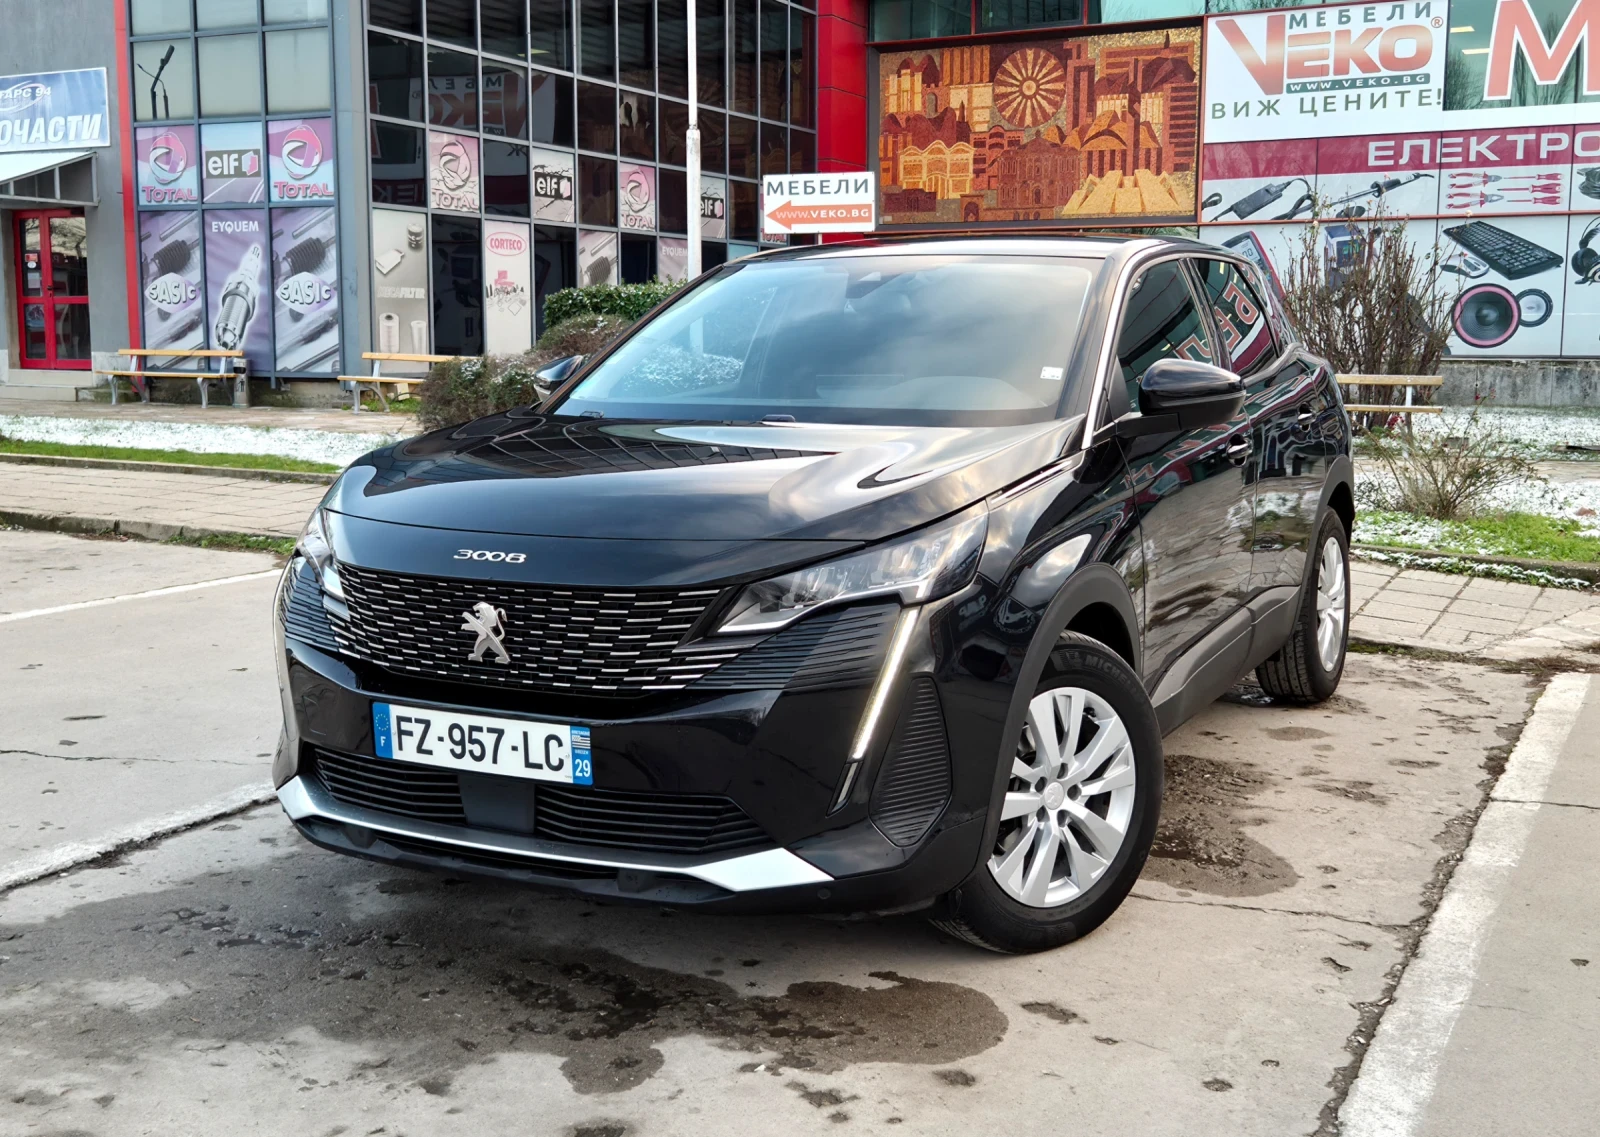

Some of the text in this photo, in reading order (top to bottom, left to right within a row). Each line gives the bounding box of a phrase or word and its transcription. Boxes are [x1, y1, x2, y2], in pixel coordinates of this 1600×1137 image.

[1289, 1, 1432, 29] МЕБЕЛИ
[1215, 14, 1433, 95] VEKO
[36, 86, 51, 97] 94
[1289, 74, 1426, 92] WWW.VEKO.BG
[1211, 88, 1442, 119] ВИЖ ЦЕНИТЕ!
[208, 153, 239, 175] elf
[142, 185, 198, 202] TOTAL
[273, 181, 334, 199] TOTAL
[536, 176, 558, 195] elf
[766, 178, 869, 196] МЕБЕЛИ
[432, 188, 479, 210] TOTAL
[621, 213, 655, 229] TOTAL
[776, 208, 870, 219] www.VEKO.BG
[212, 220, 259, 234] EYQUEM
[489, 237, 523, 251] CORTECO
[453, 549, 527, 564] 3008
[380, 736, 386, 747] F
[395, 715, 565, 772] FZ-957-LC
[575, 758, 591, 778] 29
